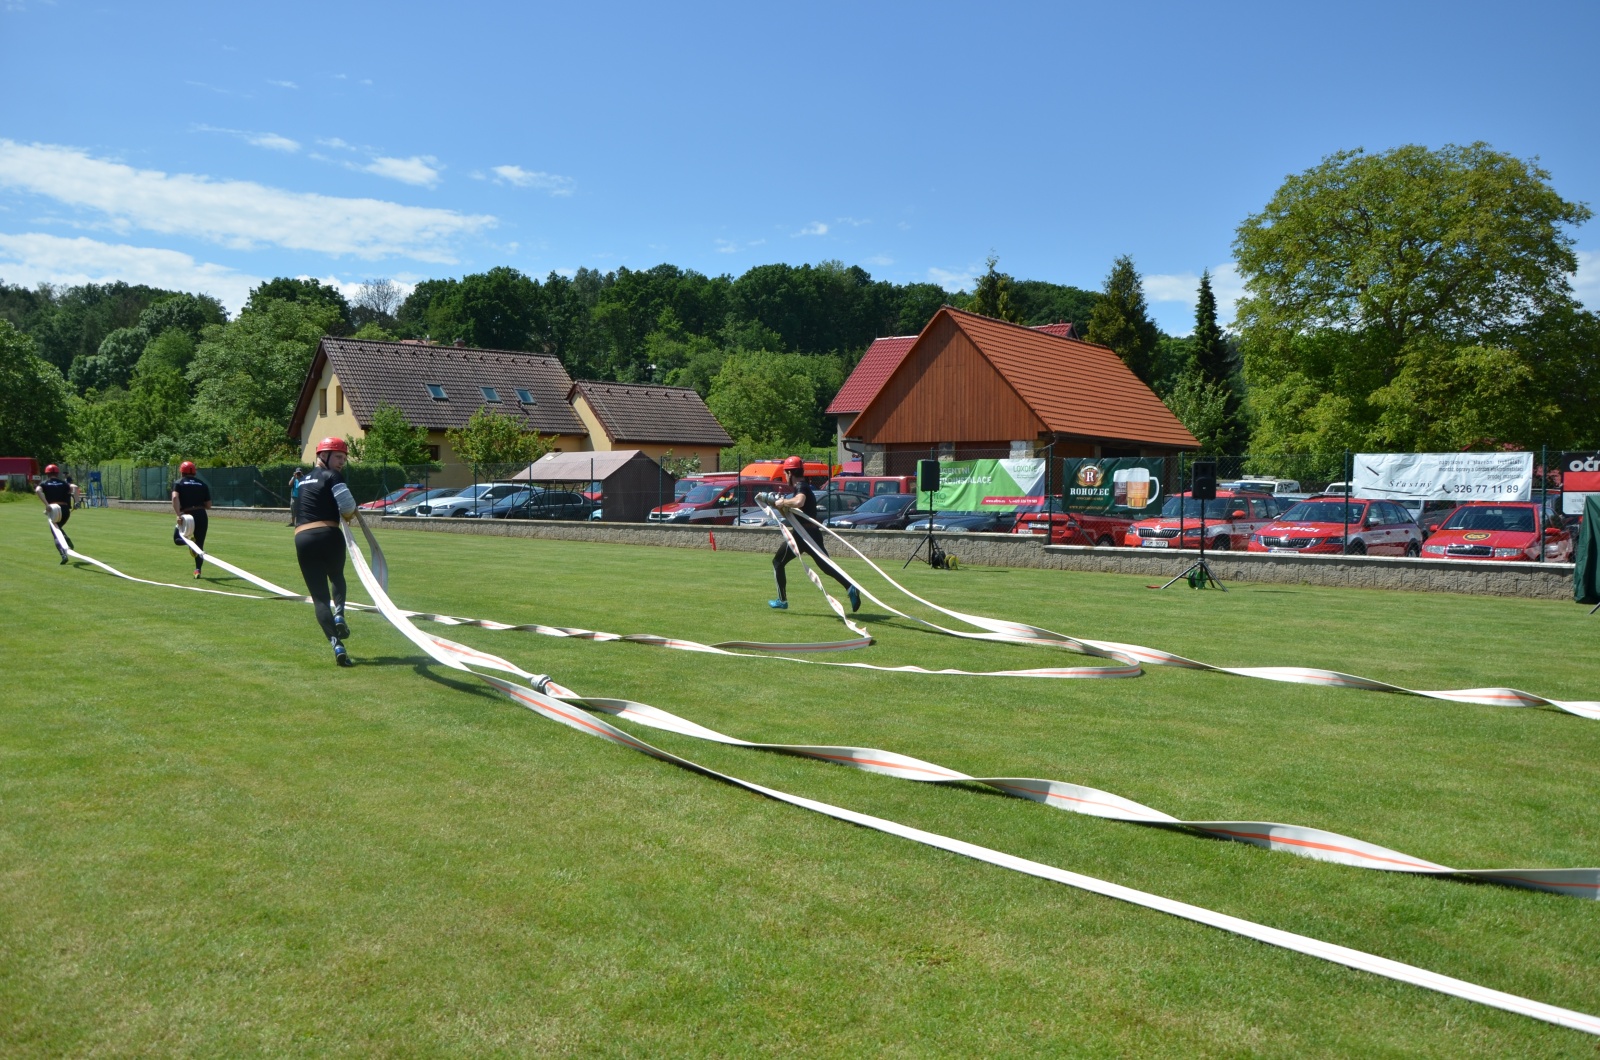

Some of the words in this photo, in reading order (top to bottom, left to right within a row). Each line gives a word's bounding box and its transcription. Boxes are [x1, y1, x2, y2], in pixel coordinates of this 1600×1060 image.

[939, 465, 969, 474] IGENTNÍ
[1086, 472, 1094, 482] R
[1070, 487, 1109, 496] ROHOZEC
[1454, 485, 1472, 493] 326
[1476, 485, 1487, 493] 77
[1491, 485, 1502, 493] 11
[1506, 485, 1518, 493] 89
